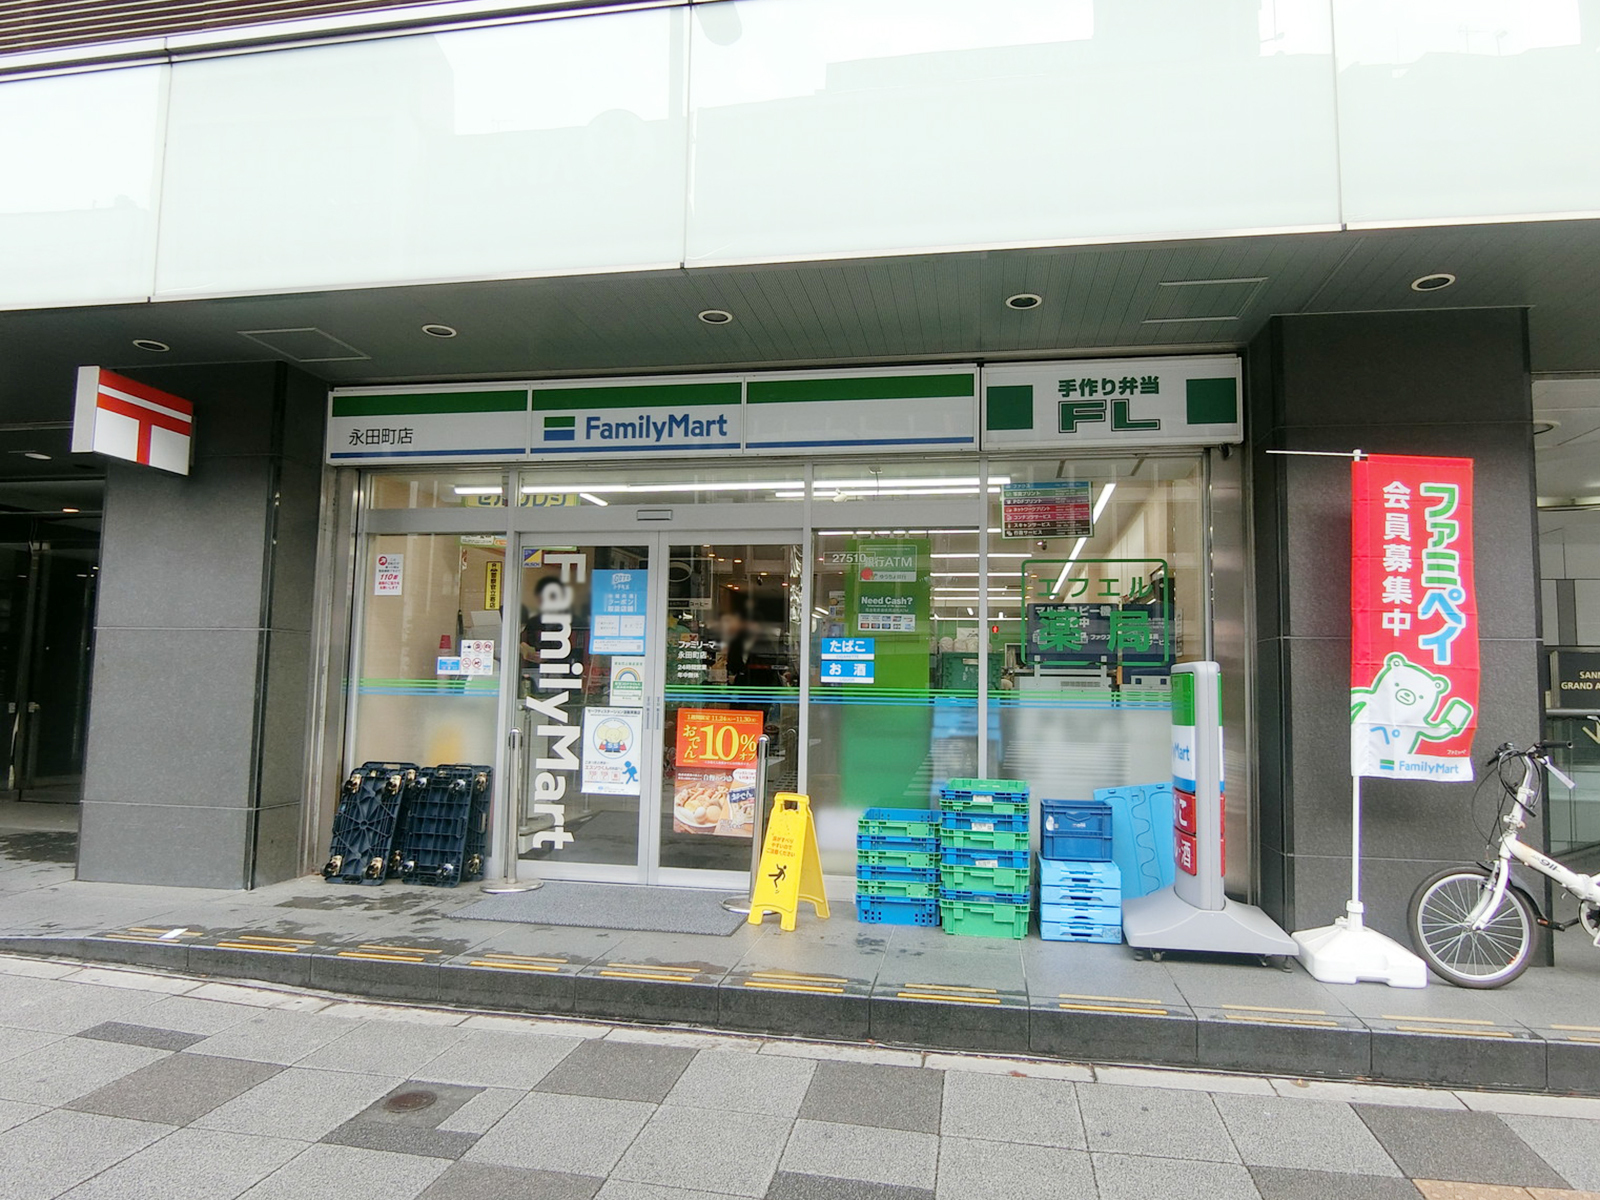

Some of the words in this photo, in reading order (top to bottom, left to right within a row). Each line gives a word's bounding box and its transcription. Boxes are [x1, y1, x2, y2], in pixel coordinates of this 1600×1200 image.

[1058, 376, 1160, 397] 手作り弁当
[1058, 399, 1160, 433] FL
[348, 427, 414, 446] 永田町店
[586, 413, 728, 443] FamilyMart
[832, 553, 866, 563] 27510
[1382, 481, 1412, 637] 会員募集中
[1418, 482, 1466, 665] ファミペイ
[1037, 576, 1155, 598] エフエル
[861, 596, 883, 604] Need
[884, 597, 913, 605] Cash?
[678, 651, 707, 659] 永田町店
[829, 640, 866, 652] たばこ
[1561, 682, 1593, 690] GRAND
[525, 553, 586, 850] FamilyMart
[683, 724, 700, 758] おでん
[1172, 742, 1190, 761] Mart
[1398, 761, 1460, 775] FamilyMart
